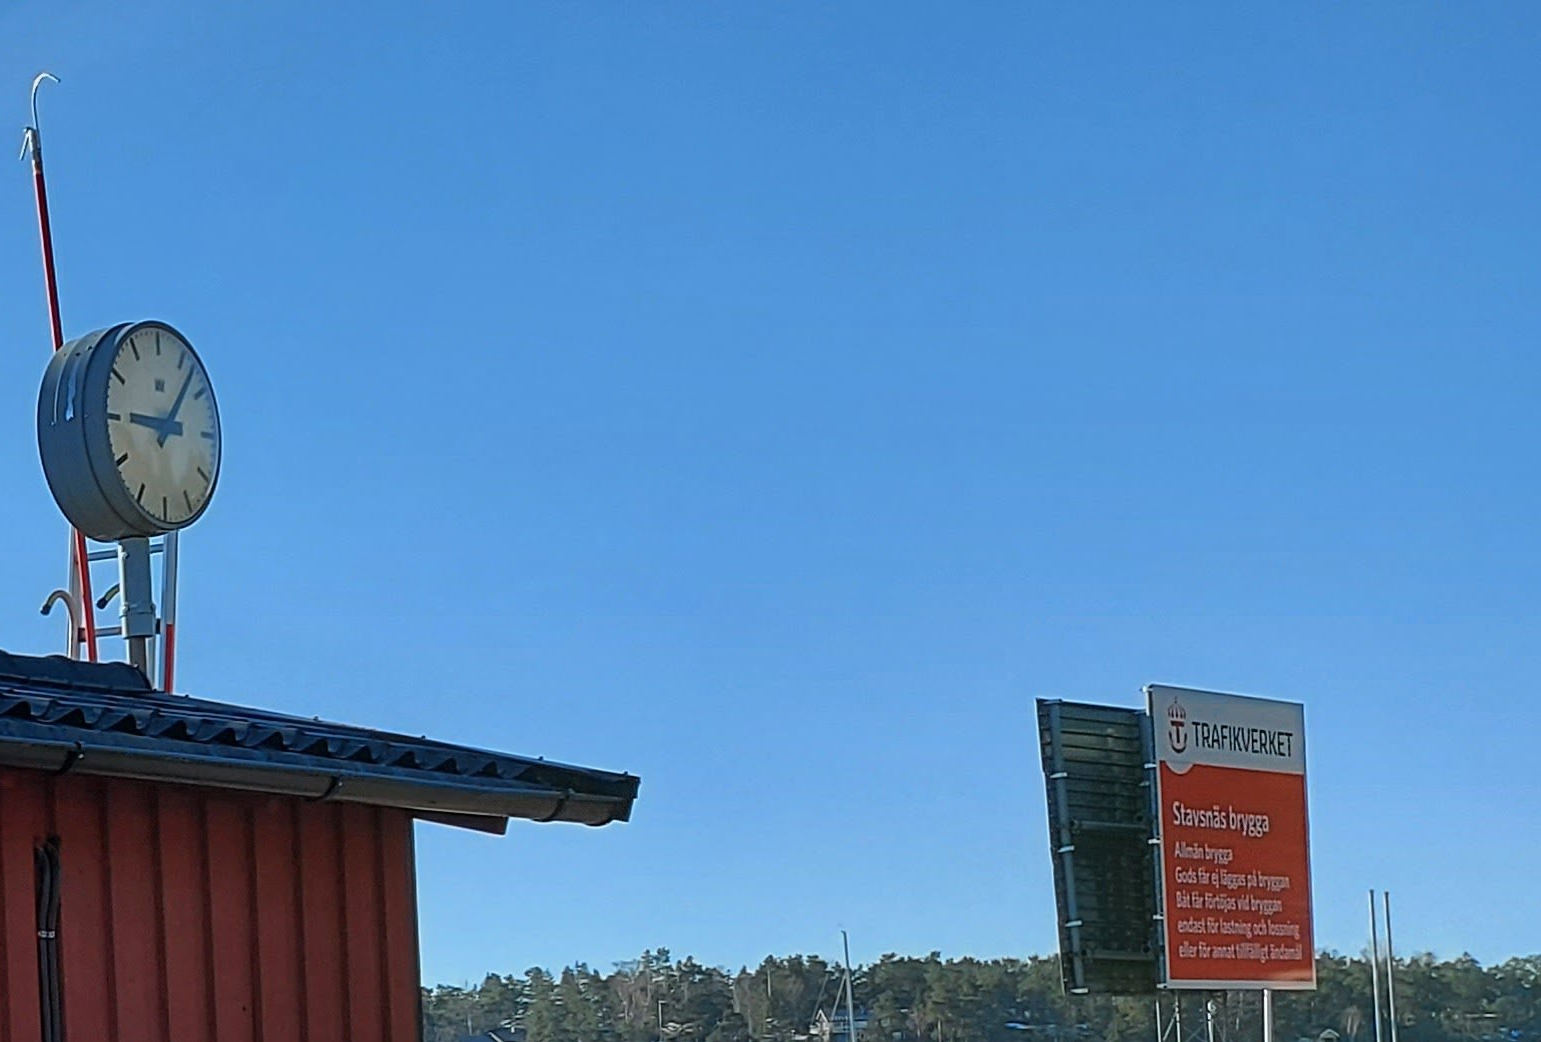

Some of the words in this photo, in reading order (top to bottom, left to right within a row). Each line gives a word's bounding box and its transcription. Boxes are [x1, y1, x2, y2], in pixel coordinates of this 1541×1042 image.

[1192, 721, 1293, 757] TRAFIKVERKET
[1172, 801, 1226, 829] Stavsnäs
[1229, 805, 1269, 837] brygga
[1174, 841, 1204, 860] Allmän
[1205, 844, 1233, 864] brygga
[1175, 867, 1197, 884] Gods
[1211, 869, 1219, 888] ej
[1220, 869, 1246, 889] läggas
[1247, 870, 1257, 888] på
[1258, 871, 1290, 892] bryggan
[1251, 895, 1283, 915] bryggan
[1178, 916, 1206, 933] endast
[1253, 919, 1267, 935] och
